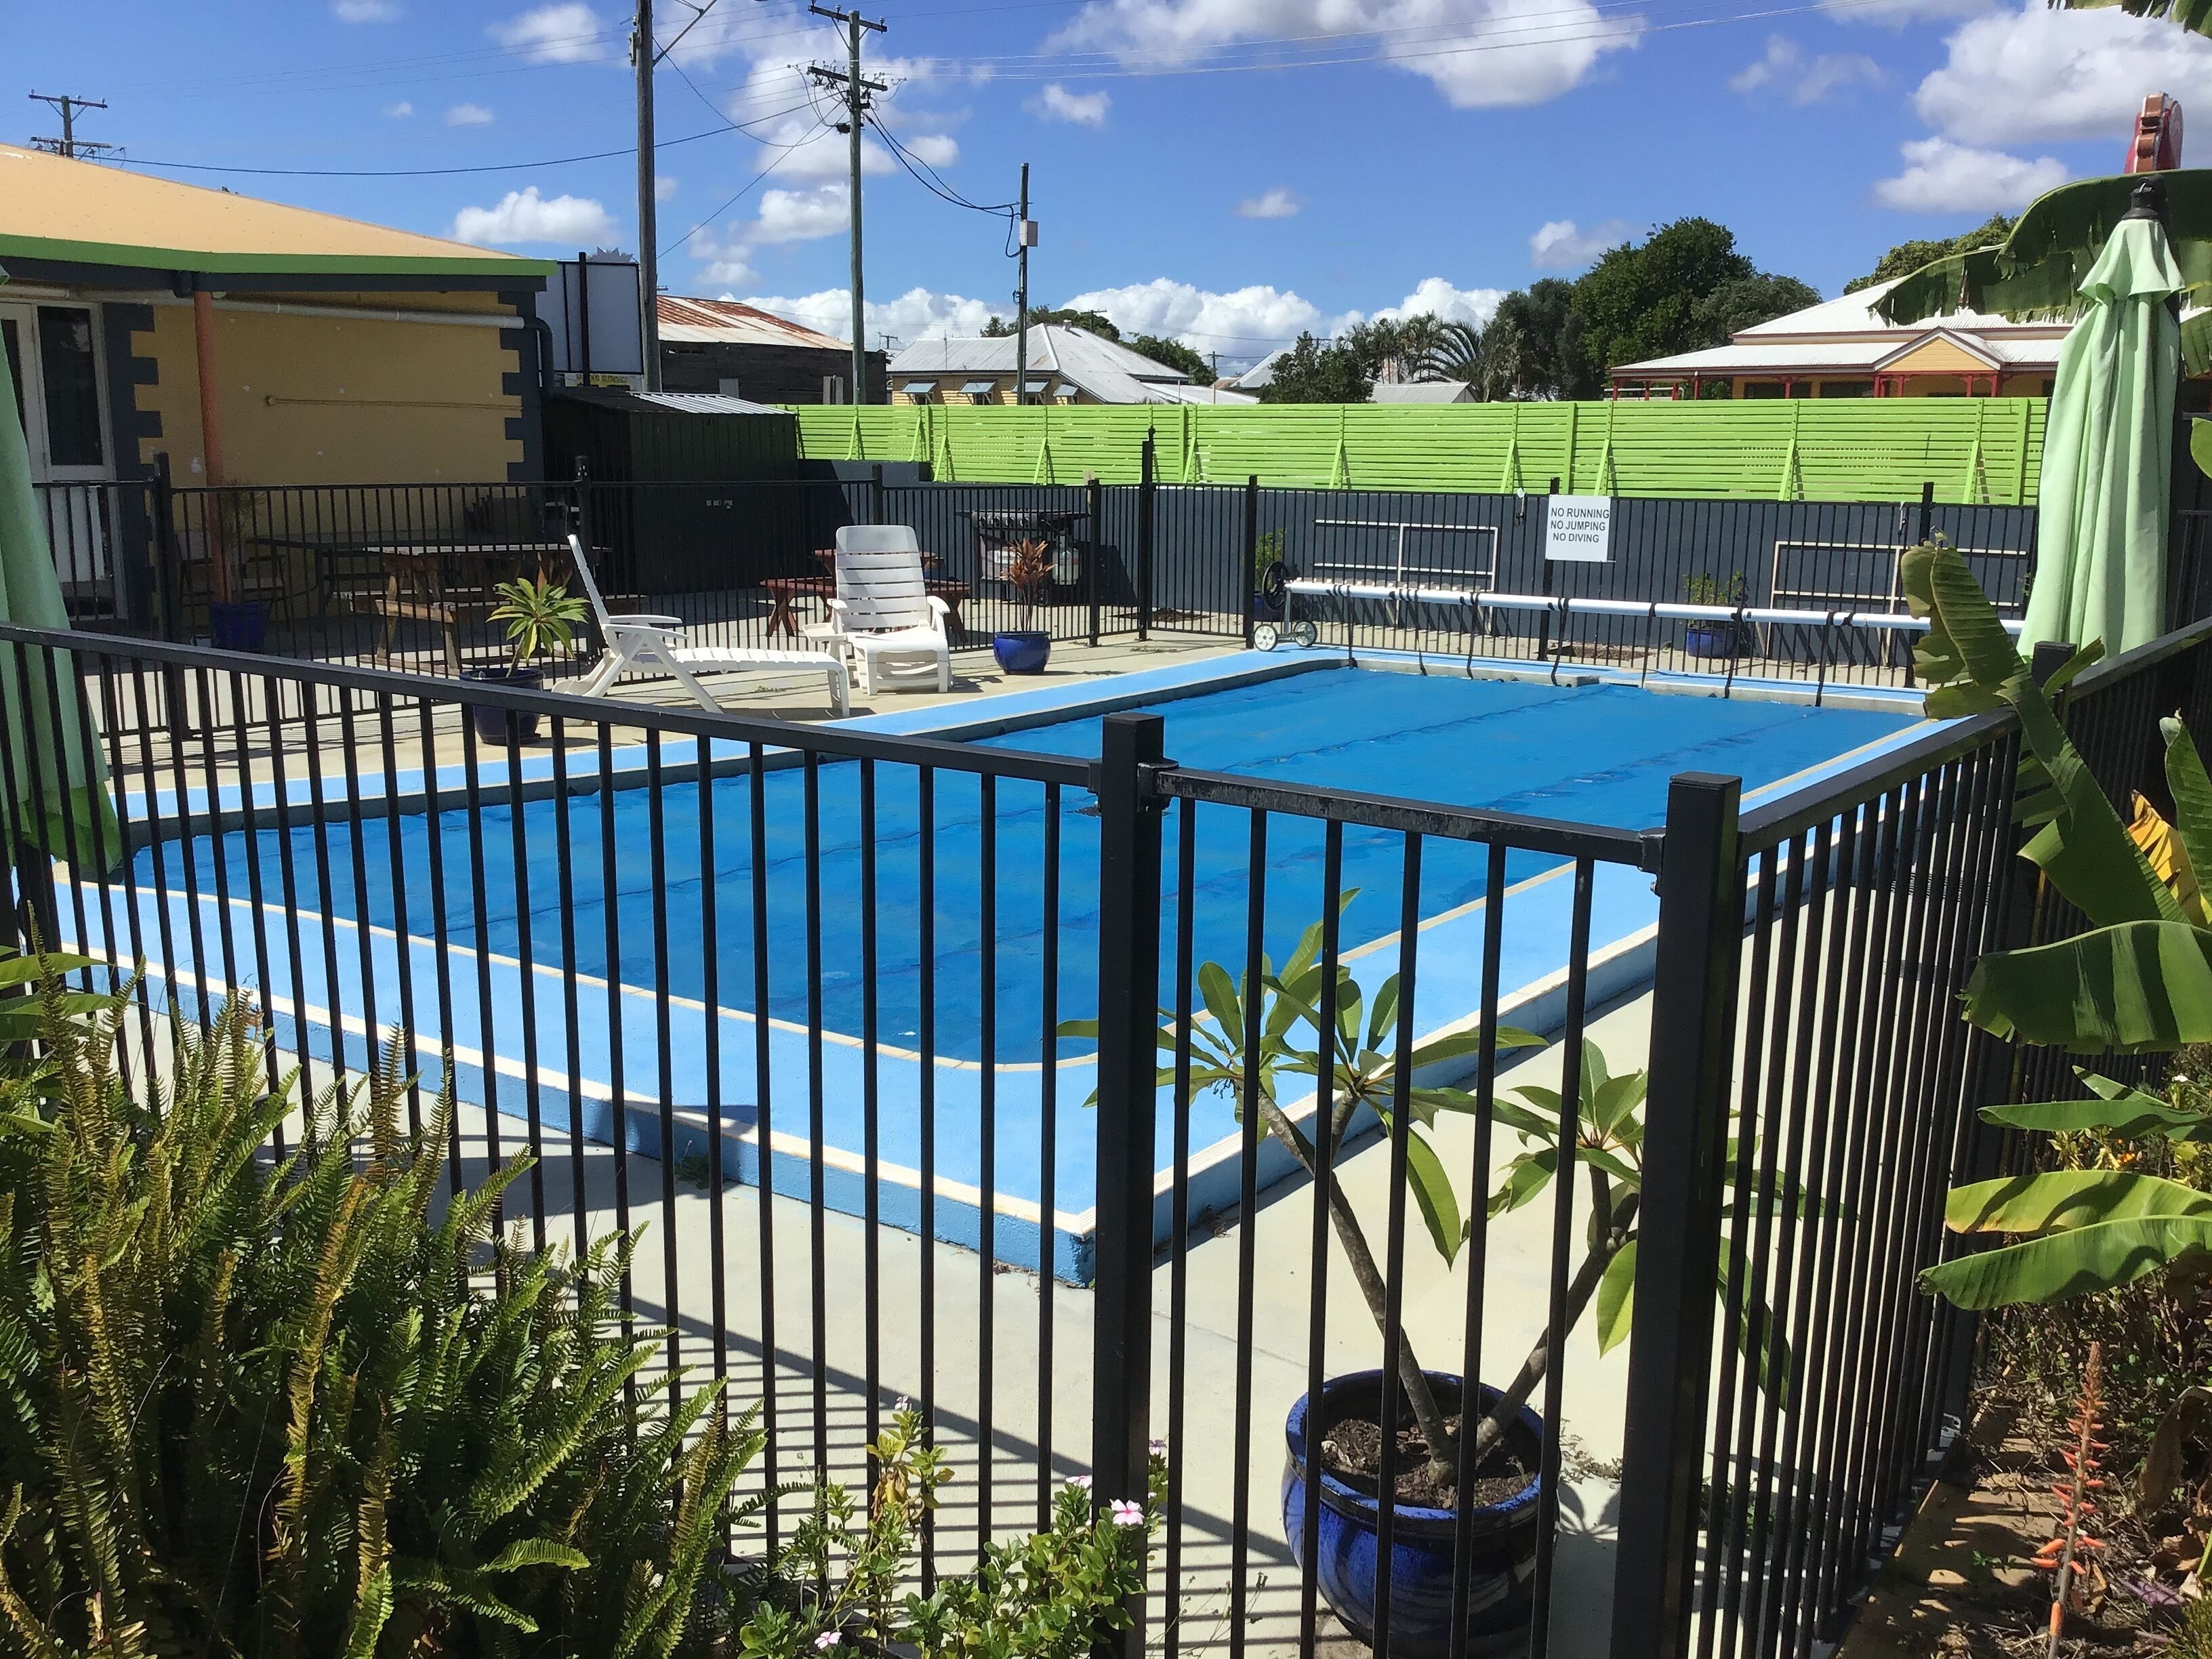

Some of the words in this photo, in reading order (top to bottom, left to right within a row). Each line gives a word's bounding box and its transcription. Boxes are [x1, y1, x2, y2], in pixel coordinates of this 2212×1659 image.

[1551, 508, 1564, 516] NO
[1567, 508, 1610, 518] RUNNING
[1551, 520, 1563, 529] NO
[1565, 521, 1605, 531] JUMPING
[1553, 533, 1566, 541] NO
[1568, 533, 1599, 543] DIVING
